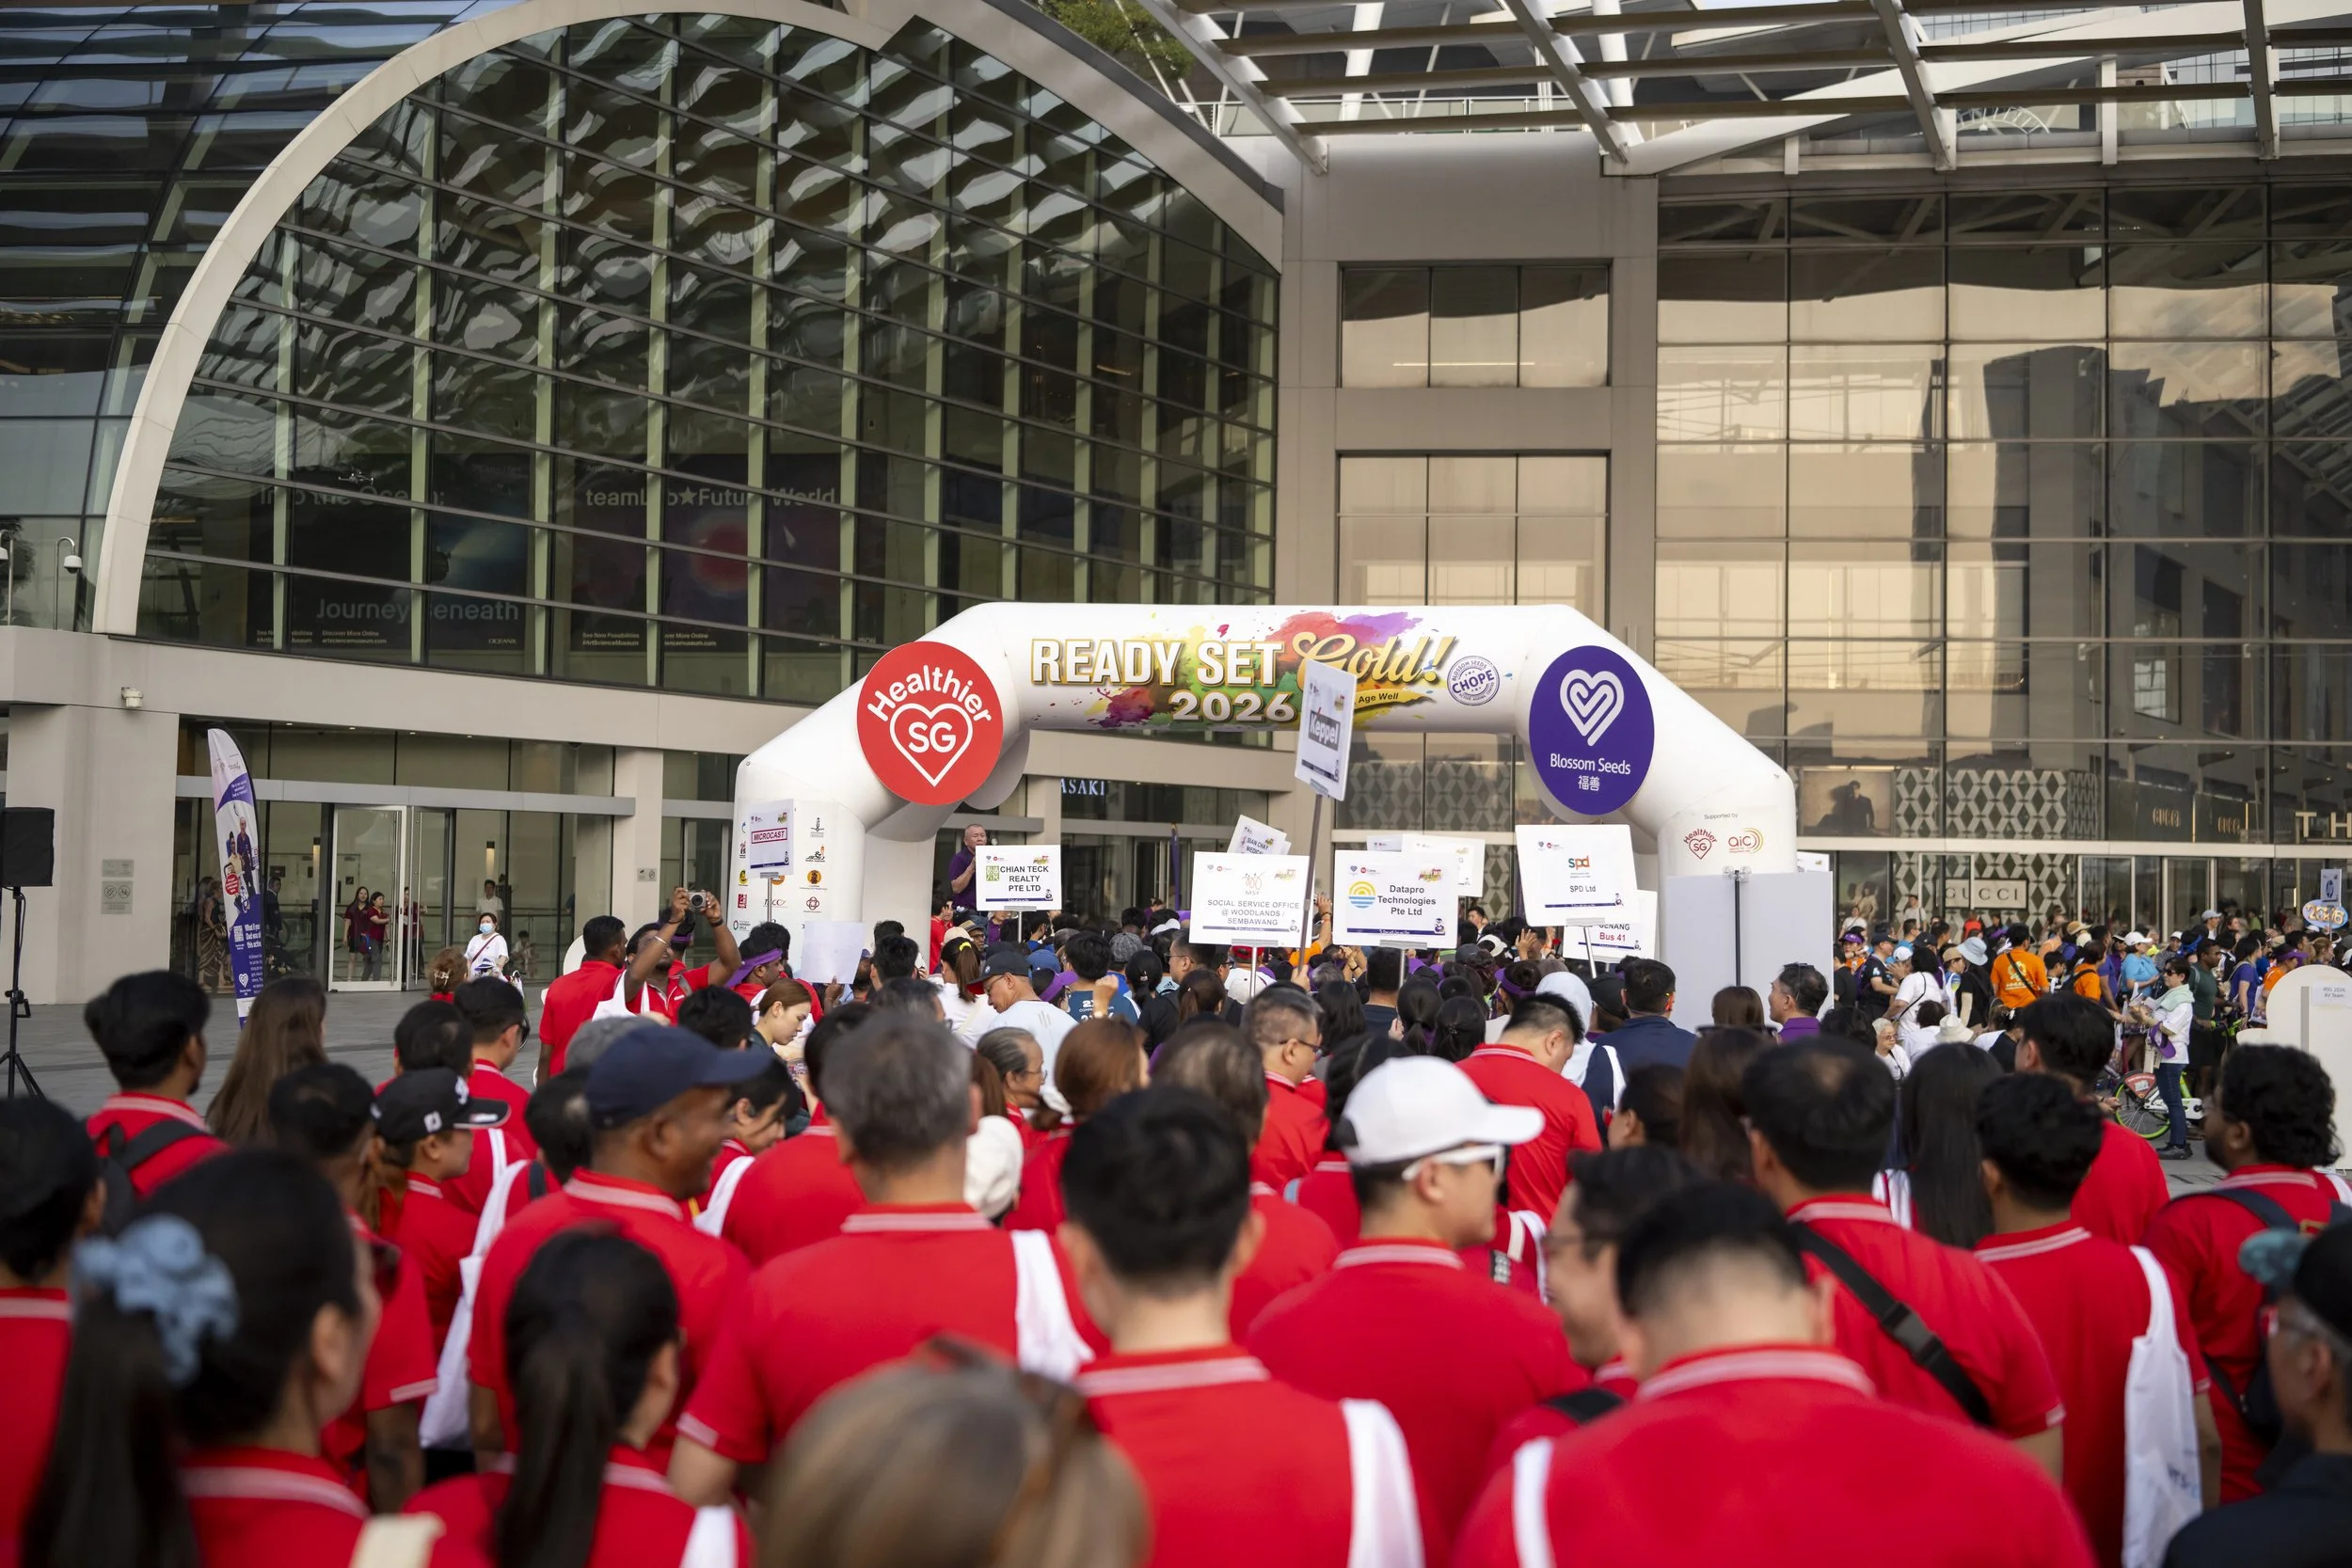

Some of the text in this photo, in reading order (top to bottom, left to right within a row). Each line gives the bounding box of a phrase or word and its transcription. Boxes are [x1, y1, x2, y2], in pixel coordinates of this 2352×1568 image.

[316, 598, 519, 624] Journey eneath
[1031, 639, 1183, 685] READY
[1197, 641, 1284, 687] SET
[1470, 660, 1486, 669] SEEDS
[1452, 670, 1495, 693] CHOPE
[867, 665, 992, 721] Healthier
[1359, 692, 1399, 704] Age Well
[1168, 689, 1299, 722] 2026
[1310, 713, 1339, 745] Keppel
[908, 721, 957, 753] SG
[1550, 753, 1630, 774] Blossom Seeds
[1578, 775, 1600, 791] 福善
[754, 831, 785, 841] MICROCAST
[1247, 837, 1258, 847] SIAN
[1683, 828, 1717, 844] Healthier
[1693, 843, 1708, 851] SG
[1567, 855, 1590, 870] spd
[1390, 884, 1424, 895] Datapro
[1377, 895, 1437, 906] Technologies
[1231, 909, 1280, 917] WOODLANDS
[1391, 907, 1422, 916] Pte Ltd
[1227, 917, 1279, 926] SEMBAWANG
[1599, 932, 1614, 941] Bus
